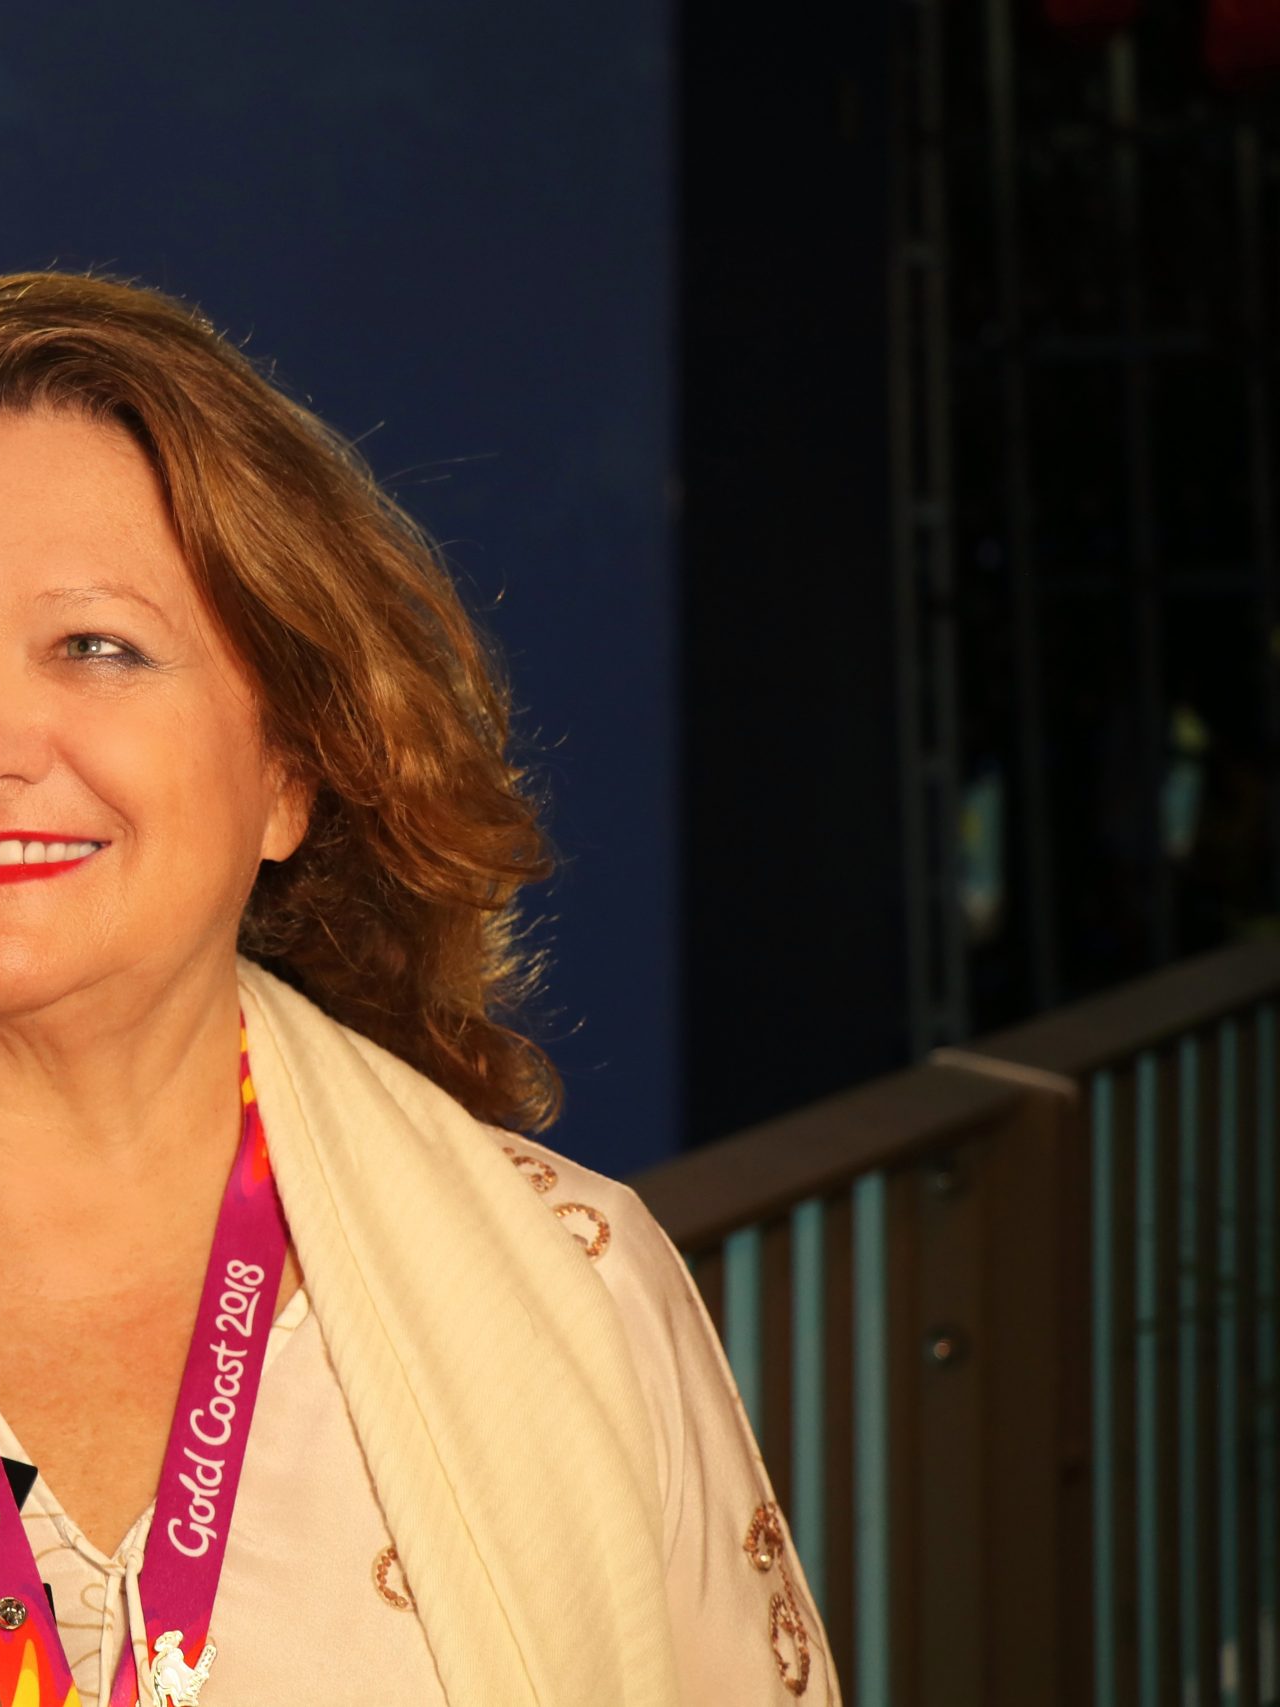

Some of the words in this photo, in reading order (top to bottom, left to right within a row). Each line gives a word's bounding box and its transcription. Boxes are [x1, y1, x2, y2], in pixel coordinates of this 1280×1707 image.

[216, 1259, 265, 1337] 2018
[189, 1339, 248, 1446] Coast
[167, 1447, 225, 1557] Gold
